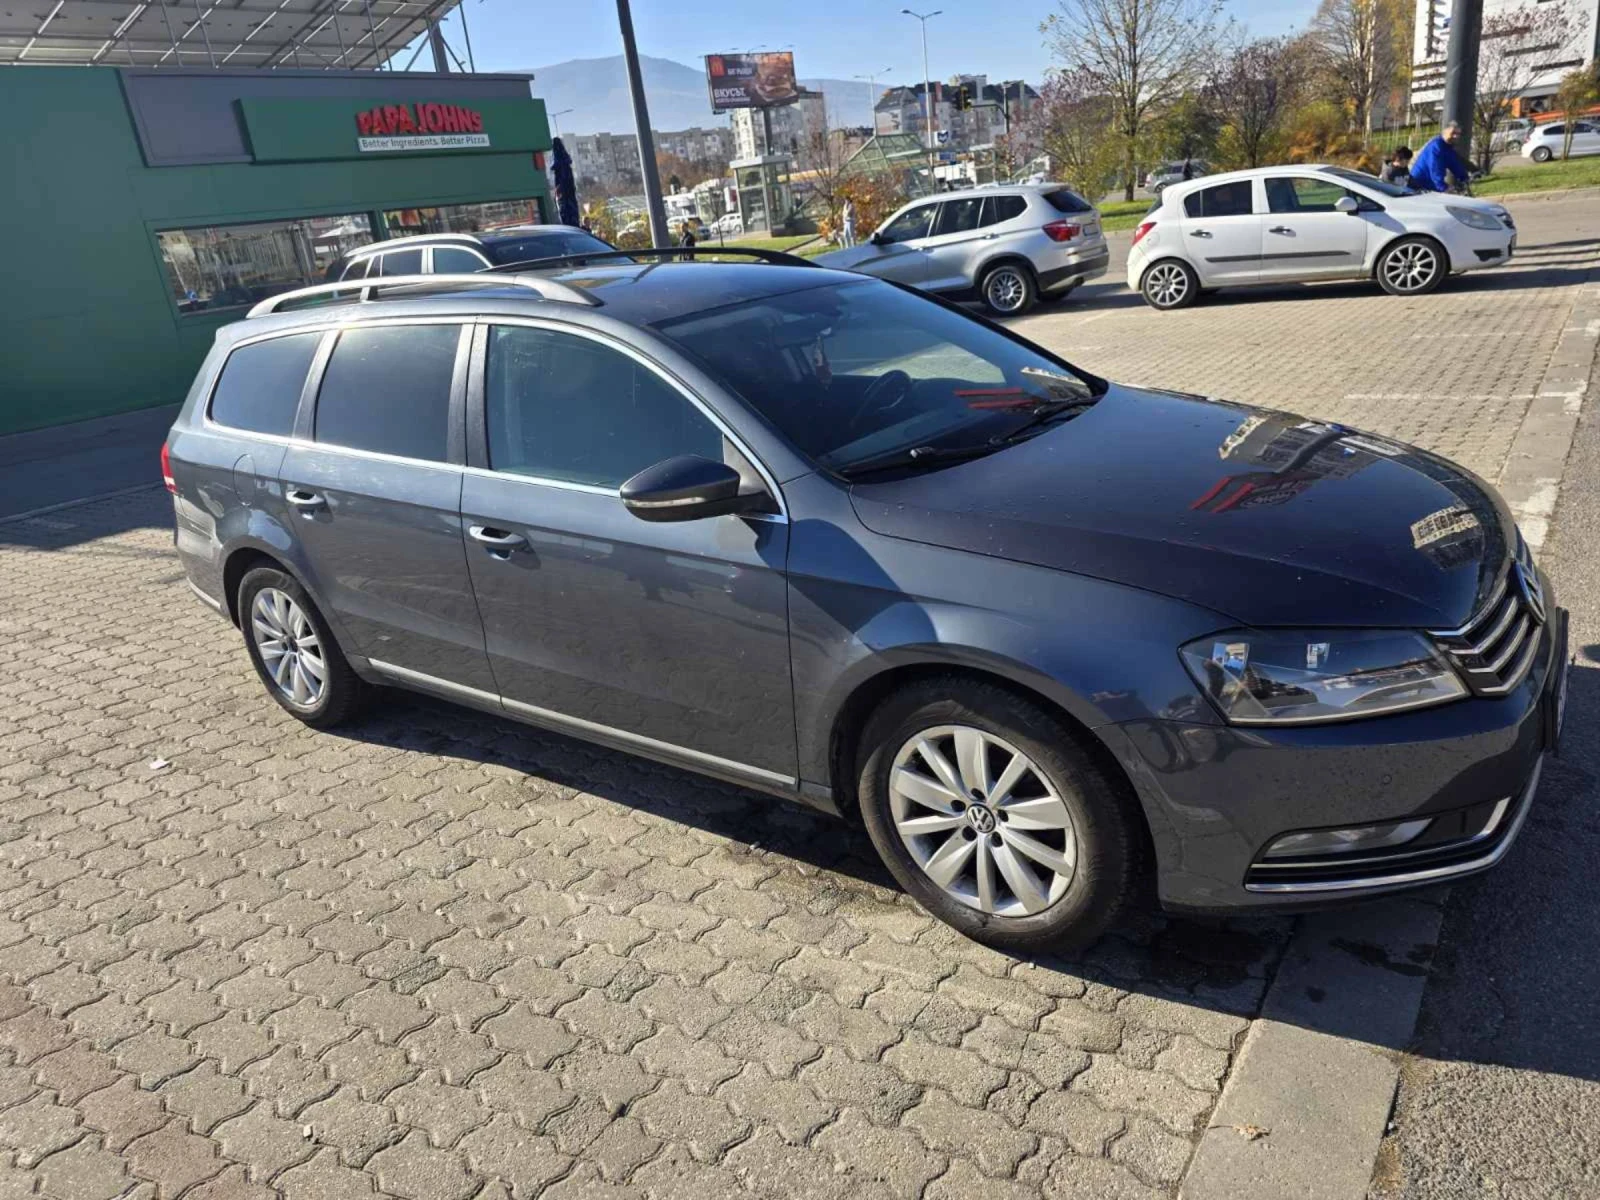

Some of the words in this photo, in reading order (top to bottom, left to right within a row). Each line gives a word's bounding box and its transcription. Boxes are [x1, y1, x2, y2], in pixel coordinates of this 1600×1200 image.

[356, 104, 416, 135] PAPA
[415, 102, 483, 134] JOHNS
[361, 138, 389, 149] Better
[391, 137, 440, 149] Ingredients.
[441, 136, 465, 145] Better
[466, 135, 488, 144] Pizza.
